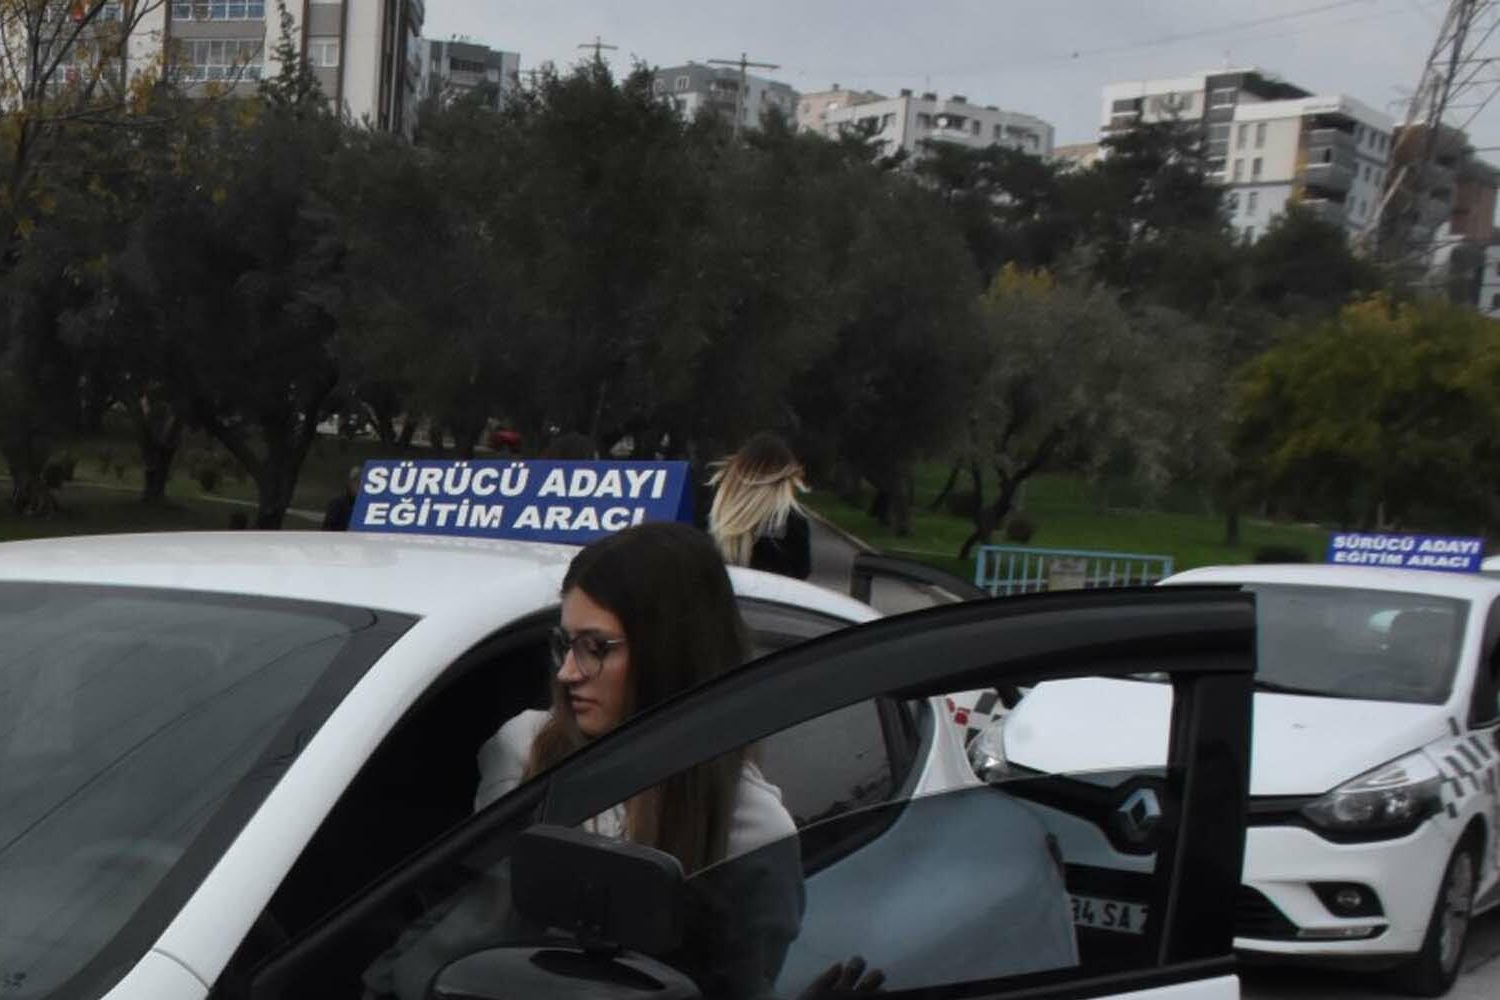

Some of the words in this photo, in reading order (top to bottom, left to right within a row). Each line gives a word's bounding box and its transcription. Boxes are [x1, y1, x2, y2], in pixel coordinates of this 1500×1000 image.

[364, 461, 529, 496] SÜRÜCÜ
[537, 468, 667, 499] ADAYI
[363, 498, 504, 528] EĞİTİM
[513, 506, 646, 532] ARACI
[1333, 534, 1415, 551] SÜRÜCÜ
[1419, 539, 1480, 554] ADAYI
[1333, 551, 1403, 565] EĞİTİM
[1406, 555, 1472, 568] ARACI
[1103, 903, 1130, 928] SA
